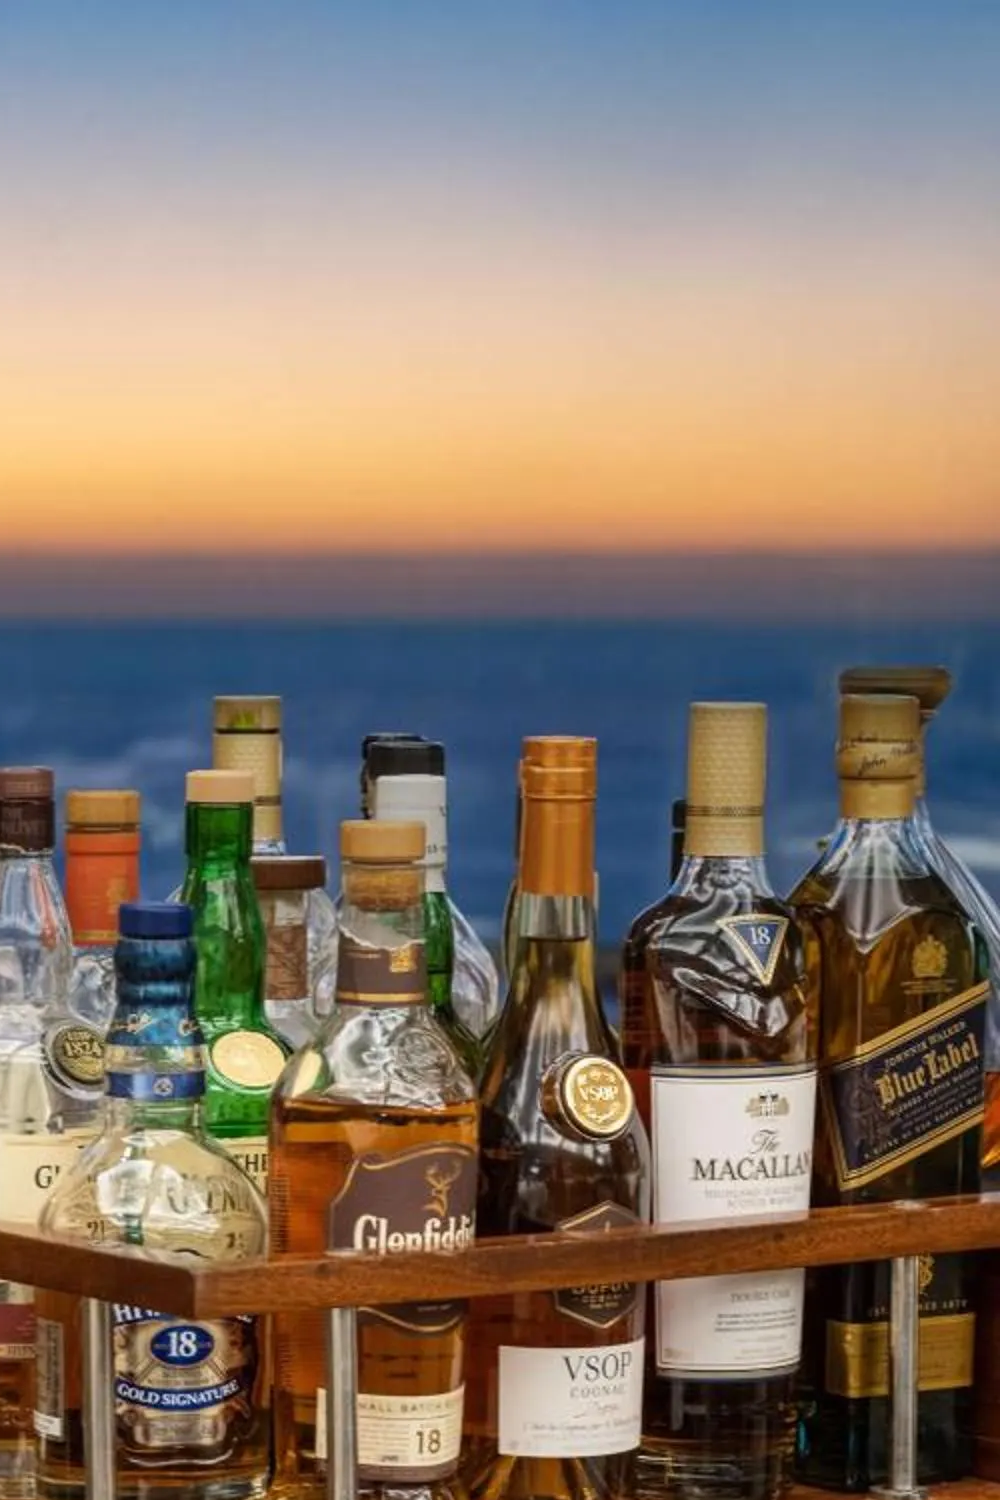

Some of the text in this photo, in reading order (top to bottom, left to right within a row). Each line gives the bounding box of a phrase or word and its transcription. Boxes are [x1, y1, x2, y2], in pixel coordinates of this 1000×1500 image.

[749, 926, 771, 945] 18
[874, 1032, 980, 1111] Blue Label
[750, 1128, 780, 1154] The
[167, 1331, 198, 1358] 18
[562, 1351, 633, 1382] VSOP
[116, 1379, 240, 1407] GOLD SIGNATURE
[415, 1428, 442, 1455] 18
